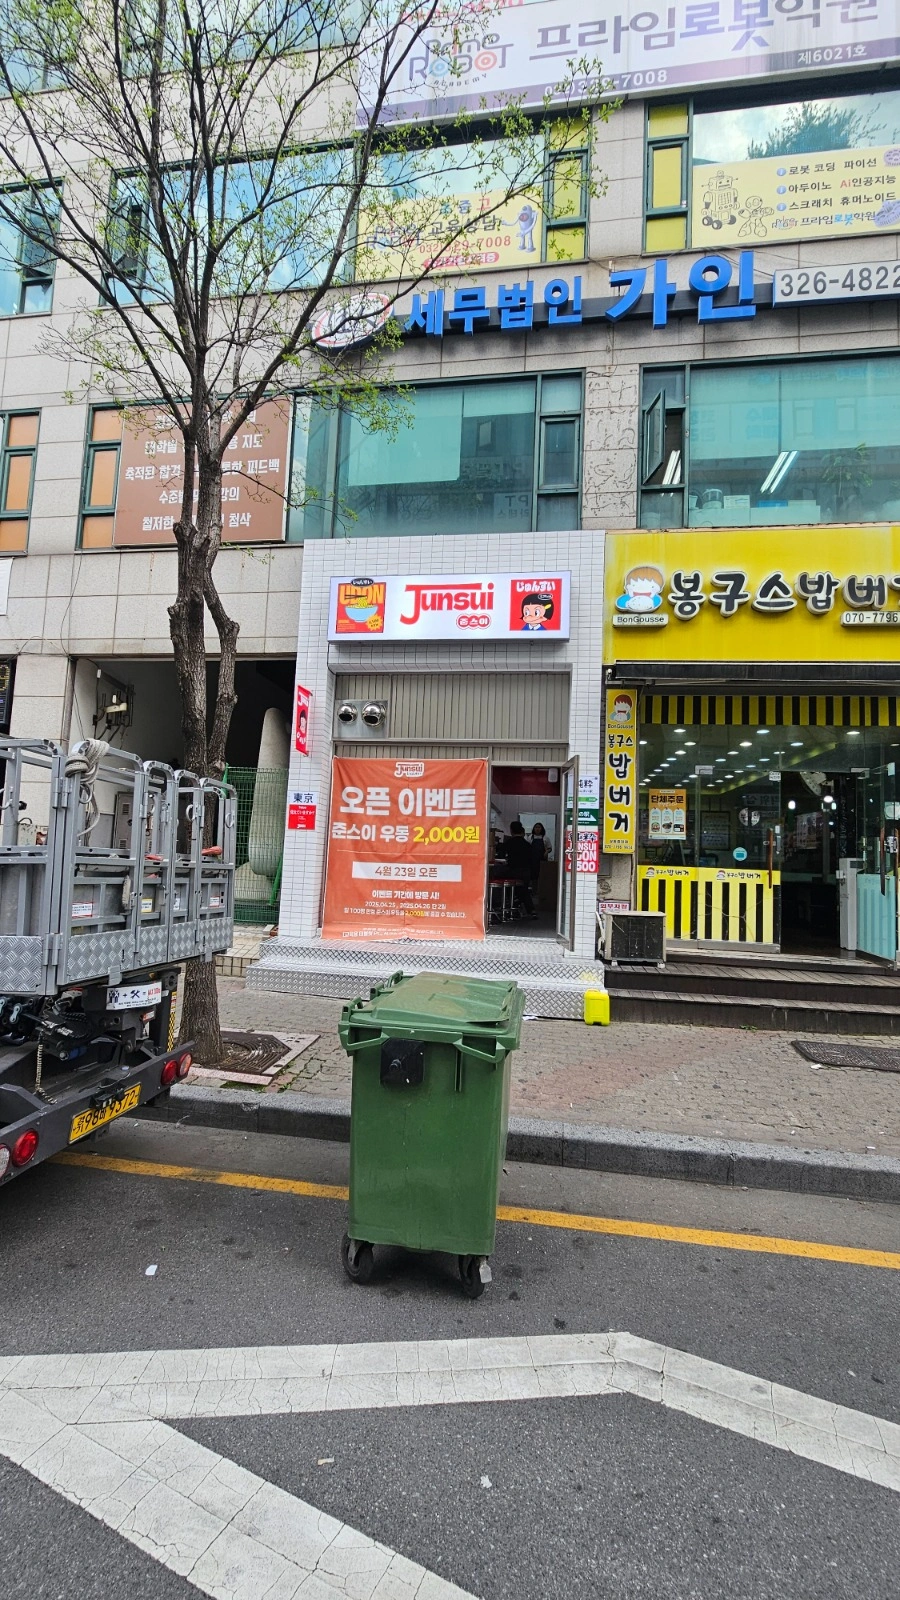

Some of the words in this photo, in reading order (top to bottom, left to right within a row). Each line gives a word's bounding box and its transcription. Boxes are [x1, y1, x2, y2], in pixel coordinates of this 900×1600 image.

[797, 44, 868, 65] 제6021호
[788, 165, 811, 176] 로봇
[814, 162, 836, 173] 코딩
[788, 181, 832, 194] 아두이노
[476, 197, 491, 211] 고
[788, 198, 833, 211] 스크래치
[840, 192, 897, 206] 휴머노이드
[404, 275, 583, 336] 세무법인
[604, 250, 757, 329] 가인
[241, 434, 264, 449] 지도
[125, 466, 155, 481] 축적된
[159, 464, 181, 479] 합격
[246, 458, 280, 474] 피드백
[142, 515, 174, 531] 철저한
[228, 512, 252, 528] 첨삭
[339, 584, 385, 605] UDON
[516, 580, 556, 593] じゅんすい
[399, 582, 495, 625] Junsui
[617, 615, 665, 625] BonGousse
[608, 733, 634, 748] 봉구스
[293, 792, 314, 803] 東京
[608, 753, 632, 833] 밥버거
[651, 795, 684, 804] 단체주문
[339, 786, 391, 816] 오픈
[398, 787, 477, 818] 이벤트
[331, 822, 376, 841] 준스이
[380, 825, 410, 843] 우동
[412, 825, 480, 846] 2,000원
[374, 866, 392, 877] 4월
[394, 866, 417, 878] 23일
[418, 868, 438, 878] 오픈
